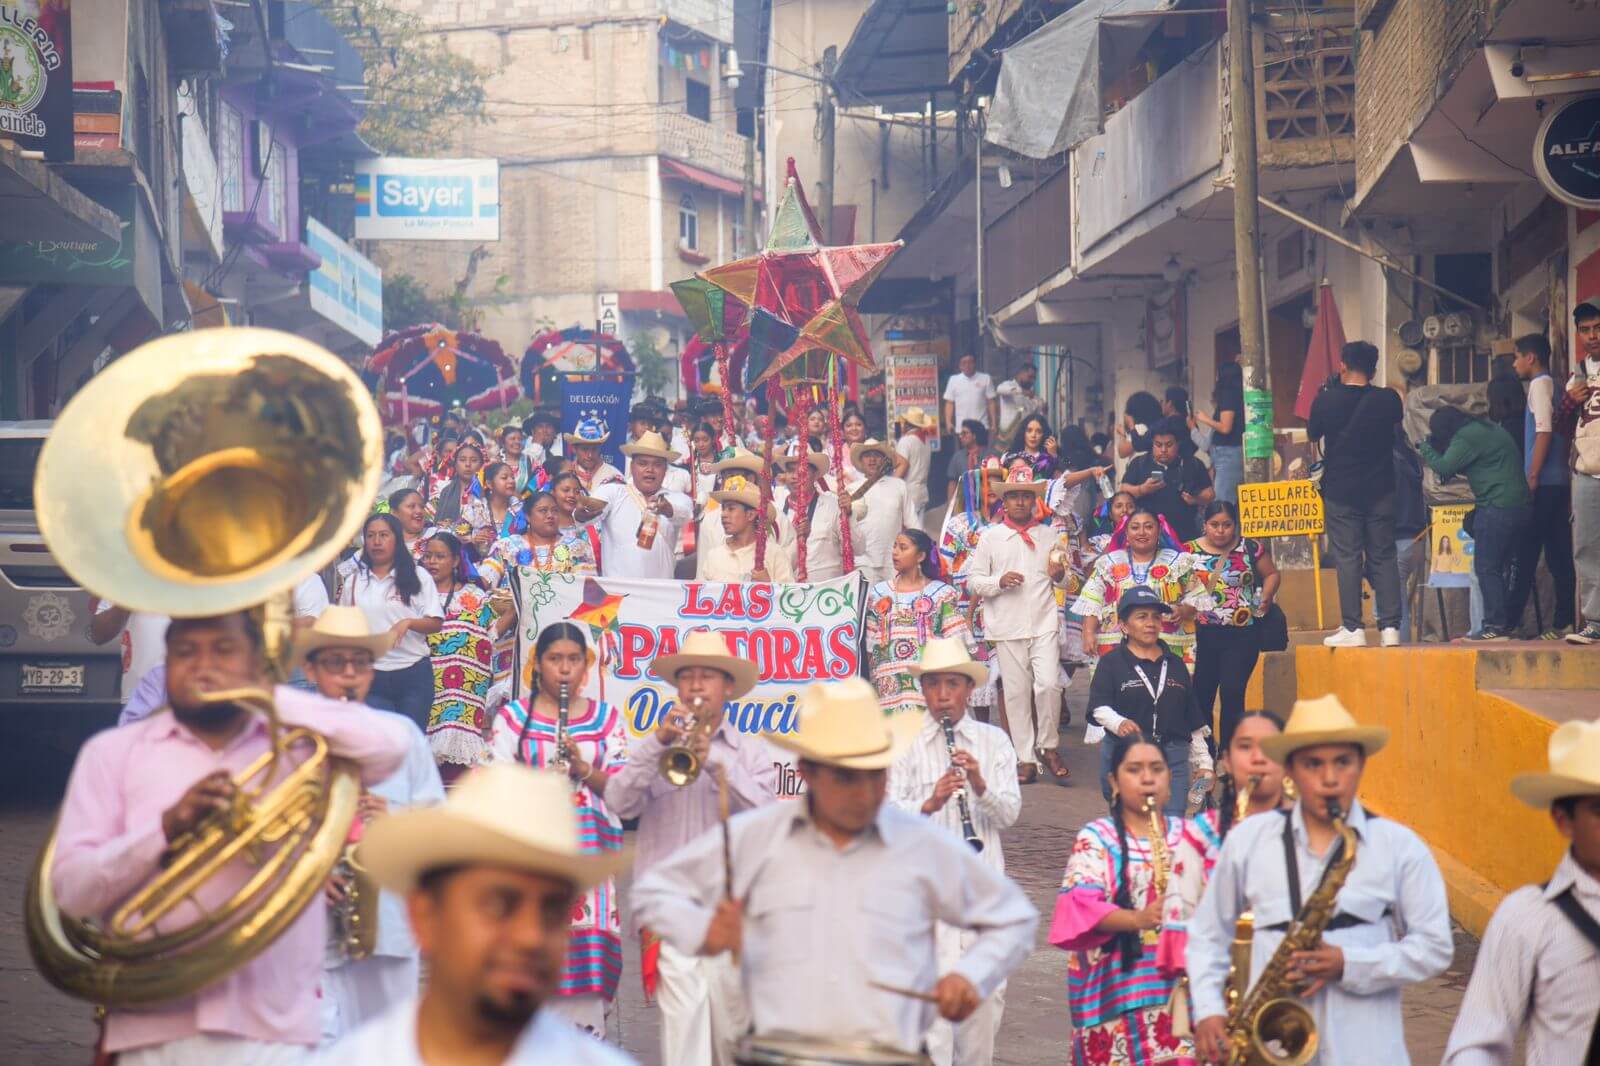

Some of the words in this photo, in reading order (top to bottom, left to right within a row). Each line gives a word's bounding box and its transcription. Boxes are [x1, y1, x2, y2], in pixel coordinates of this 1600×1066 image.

[569, 394, 620, 404] DELEGACIÓN
[1241, 486, 1318, 503] CELULARES
[1242, 503, 1319, 519] ACCESORIOS
[1242, 518, 1323, 533] REPARACIONES
[678, 583, 774, 621] LAS
[615, 623, 858, 683] PATORAS
